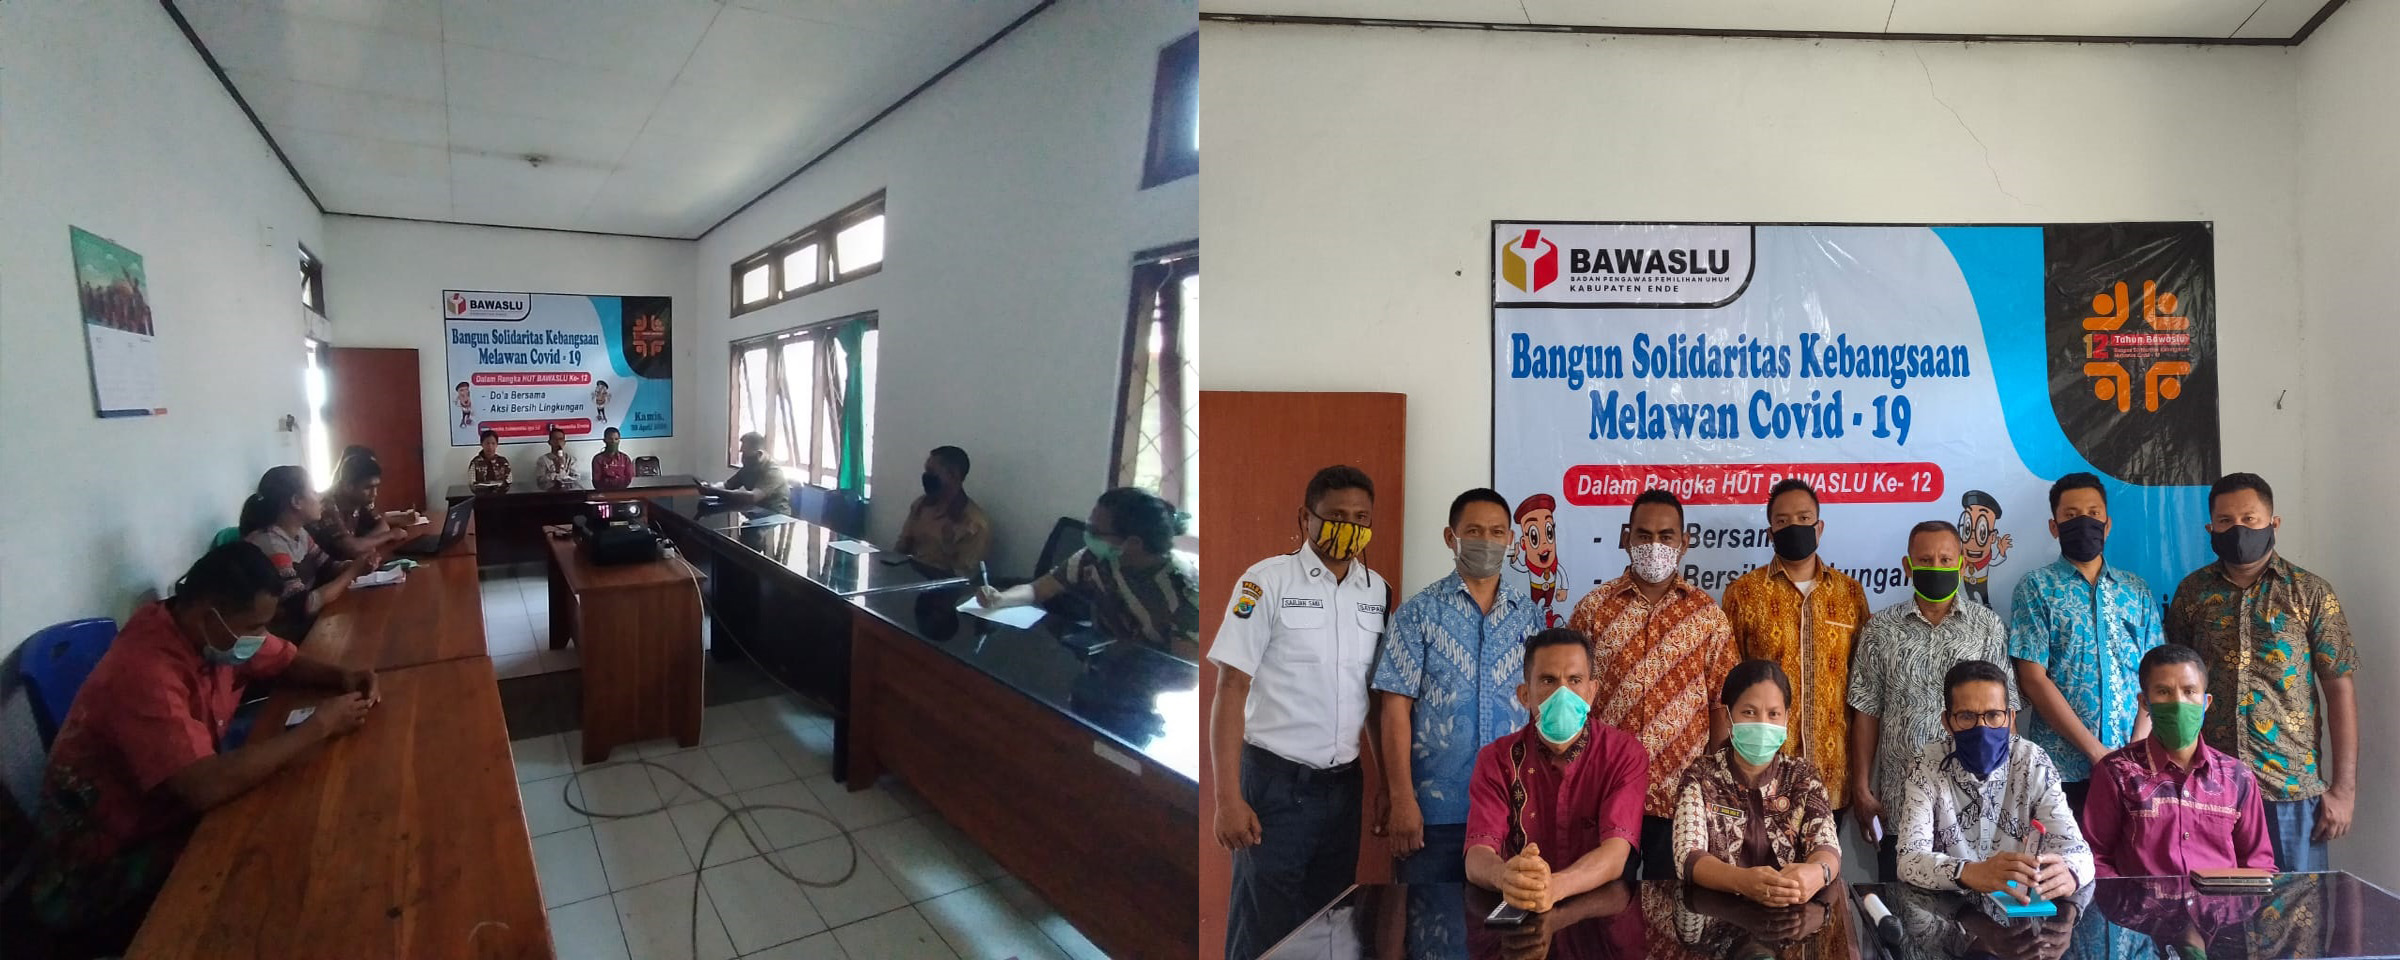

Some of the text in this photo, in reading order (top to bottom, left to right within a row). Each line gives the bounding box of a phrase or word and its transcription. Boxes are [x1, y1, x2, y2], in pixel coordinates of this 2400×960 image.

[1570, 248, 1730, 275] BAWASLU
[1569, 285, 1679, 293] KABUPATEN ENDE
[470, 300, 523, 310] BAWASLU
[451, 328, 599, 348] Bangun Solidaritas Kebangsaan
[2083, 333, 2109, 359] 12
[2114, 335, 2143, 344] Tahun
[2146, 335, 2185, 344] Bawaslu
[478, 347, 527, 365] Melawan
[530, 348, 560, 365] Covid
[569, 351, 581, 366] 19
[1510, 332, 1971, 390] Bangun Solidaritas Kebangsaan
[581, 374, 588, 382] 12
[511, 390, 546, 400] Bersama
[490, 404, 508, 412] Aksi
[511, 403, 536, 412] Bersih
[539, 403, 584, 414] Lingkungan
[1588, 389, 1740, 441] Melawan
[1748, 389, 1844, 440] Covid
[1871, 394, 1912, 446] 19
[1577, 474, 1637, 496] Dalam
[1644, 473, 1716, 500] Rangka
[1722, 473, 1764, 494] HUT
[1872, 472, 1904, 493] Ke-
[1911, 471, 1932, 492] 12
